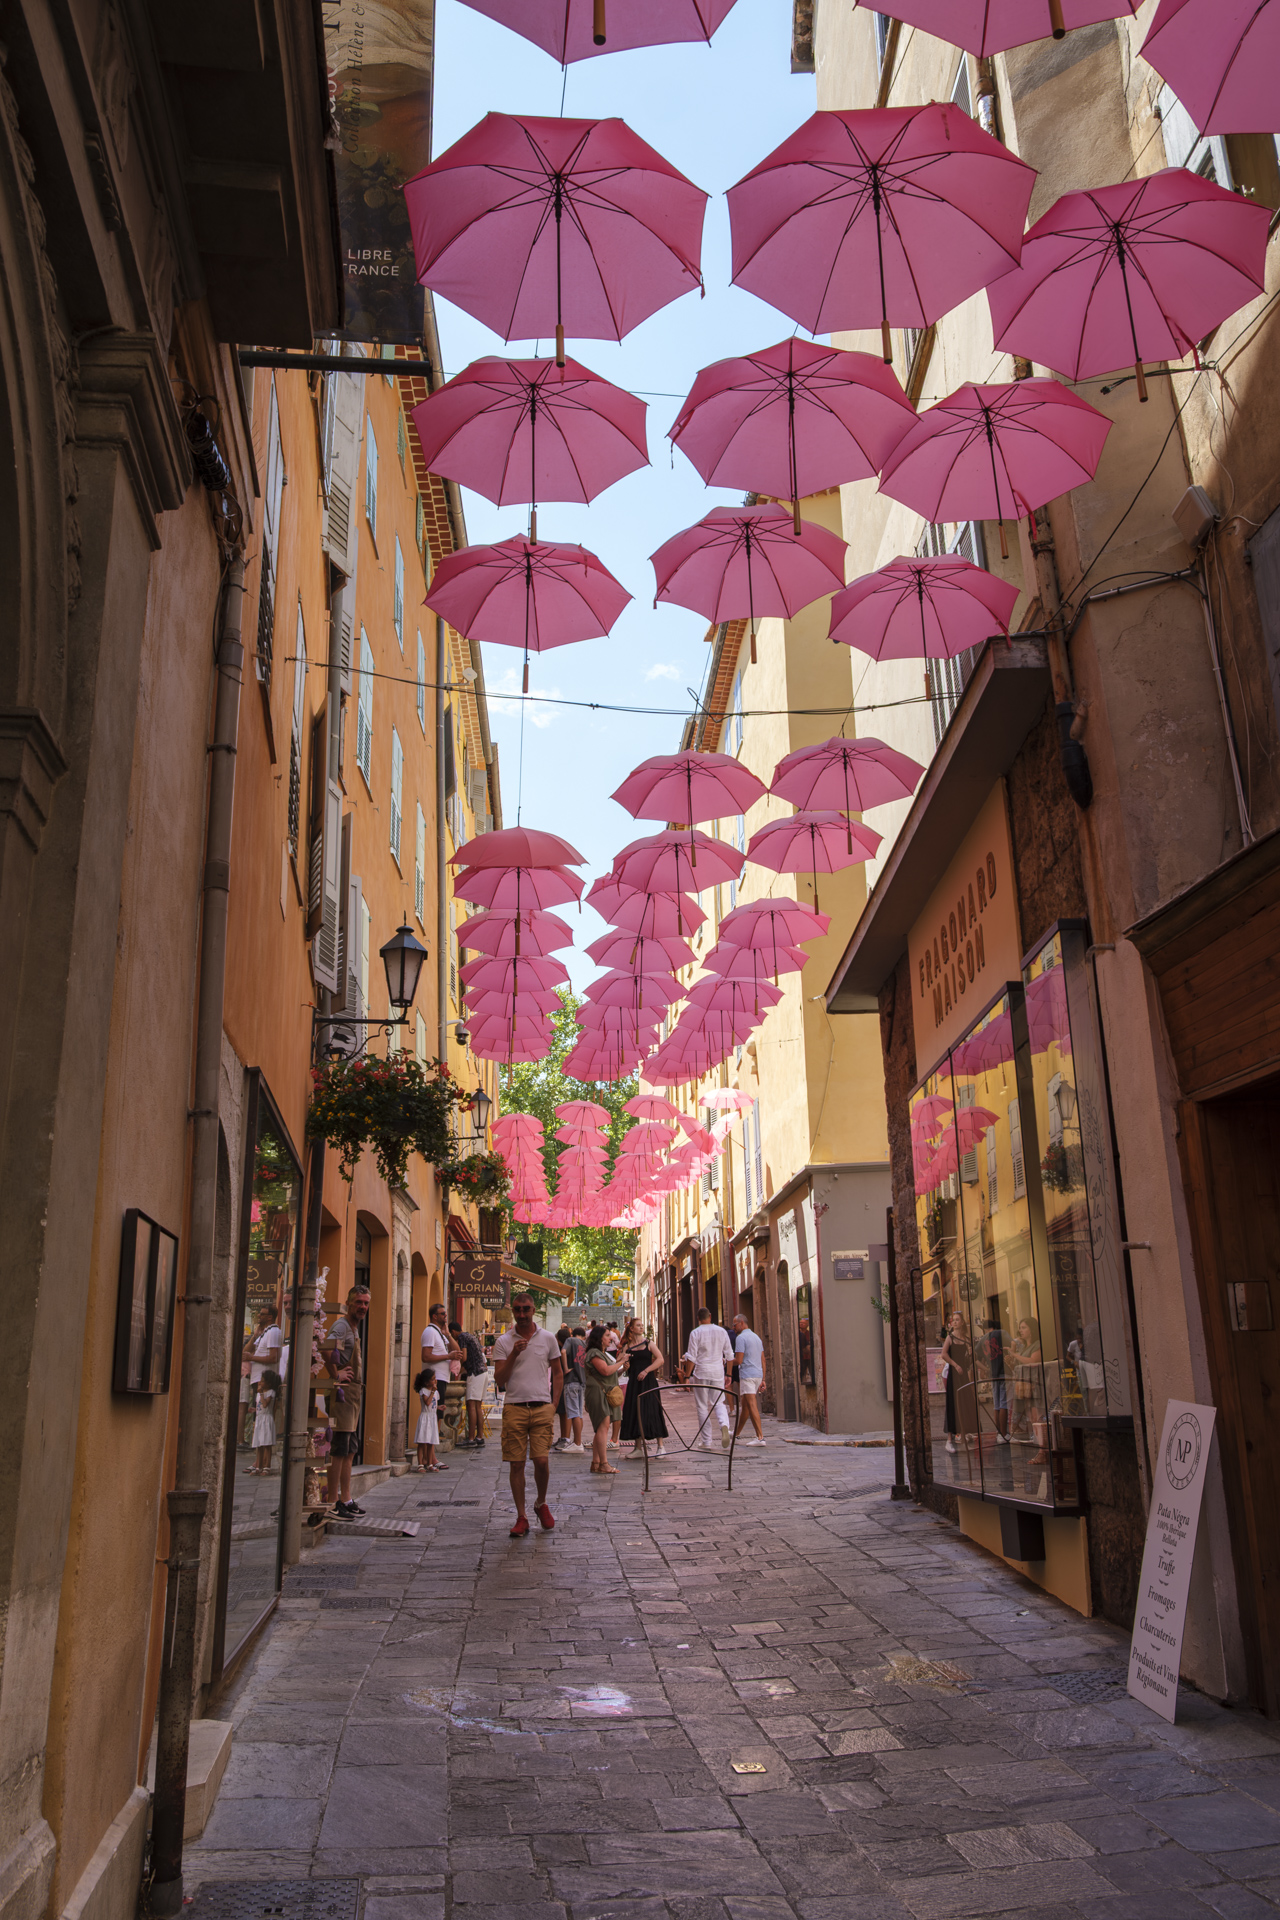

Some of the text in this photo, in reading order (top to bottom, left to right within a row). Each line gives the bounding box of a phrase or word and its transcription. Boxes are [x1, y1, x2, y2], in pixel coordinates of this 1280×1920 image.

[347, 22, 365, 71] Hélène
[342, 77, 362, 153] Collection
[348, 248, 392, 261] LIBRE
[918, 851, 997, 998] FRAGONARD
[932, 923, 985, 1029] MAISON
[454, 1283, 500, 1292] FLORIAN
[1156, 1519, 1169, 1531] 100%
[1157, 1502, 1190, 1528] Pata Négra
[1161, 1533, 1178, 1548] Bellota
[1157, 1555, 1175, 1577] Truffe
[1147, 1585, 1176, 1612] Fromages
[1139, 1615, 1177, 1647] Charcuteries
[1131, 1646, 1177, 1685] Produits et Vins
[1136, 1666, 1169, 1697] Régionaux
